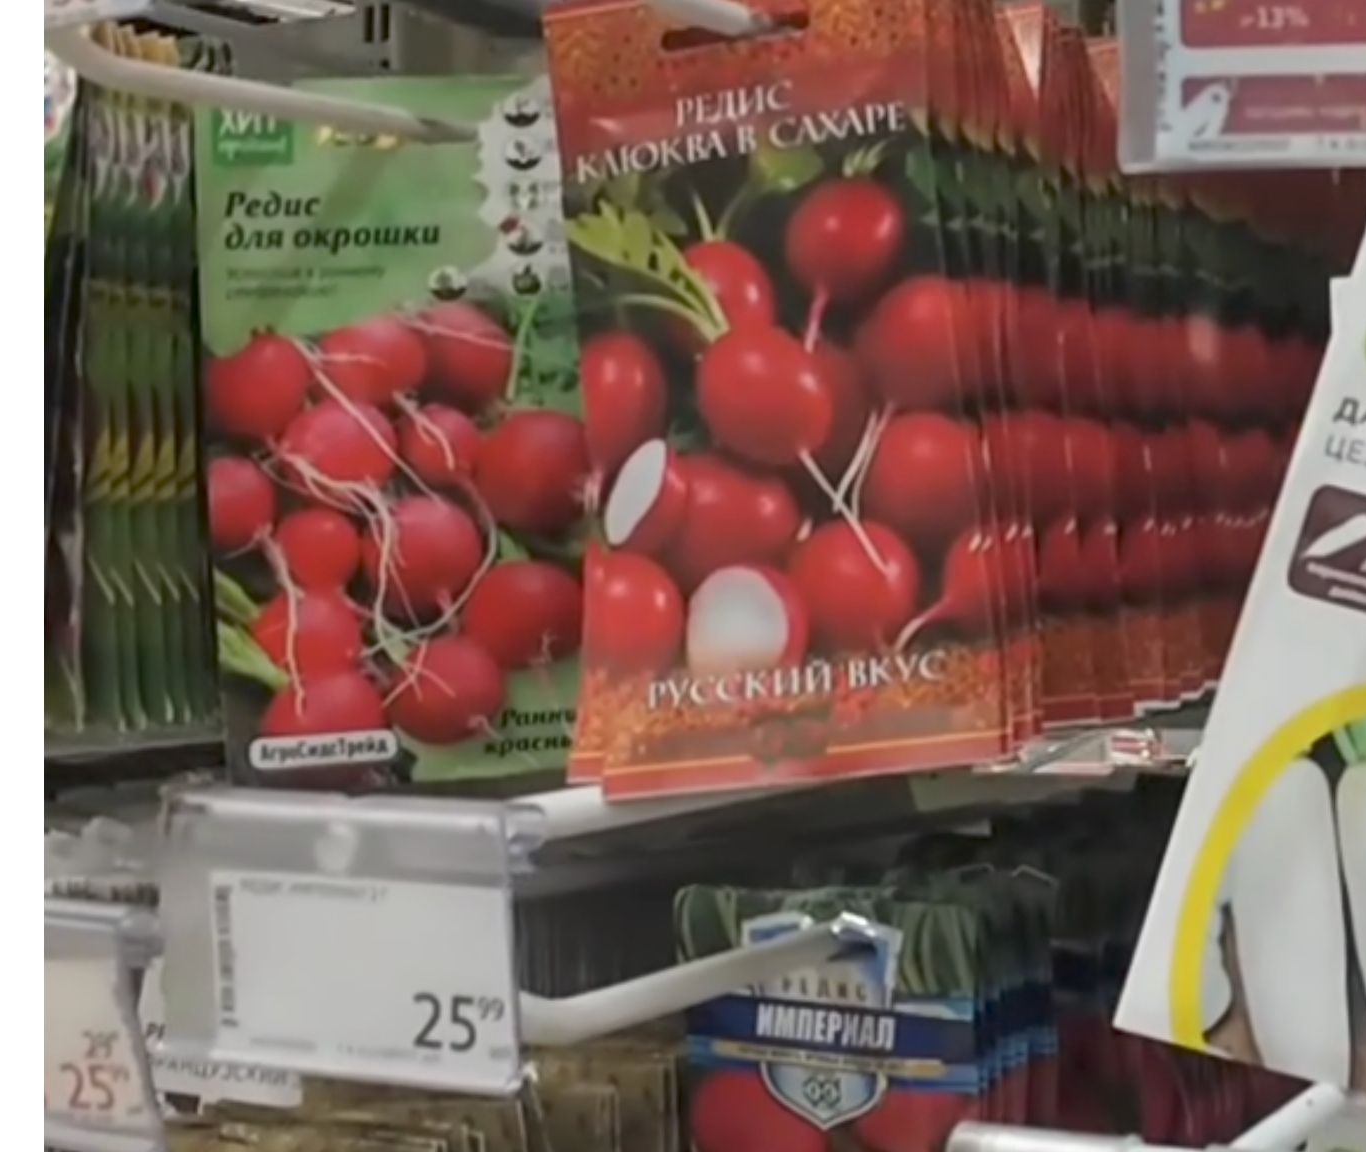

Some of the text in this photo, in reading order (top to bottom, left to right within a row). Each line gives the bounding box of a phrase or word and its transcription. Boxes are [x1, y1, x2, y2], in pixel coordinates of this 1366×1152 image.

[676, 81, 795, 127] РЕДИС
[577, 102, 906, 184] КЛЮКВА В САХАРЕ
[225, 191, 322, 218] Редис
[224, 223, 441, 255] для окрошки
[648, 651, 948, 709] РУССКИЙ ВКУС
[756, 1003, 895, 1050] ИМПЕРИАЛ
